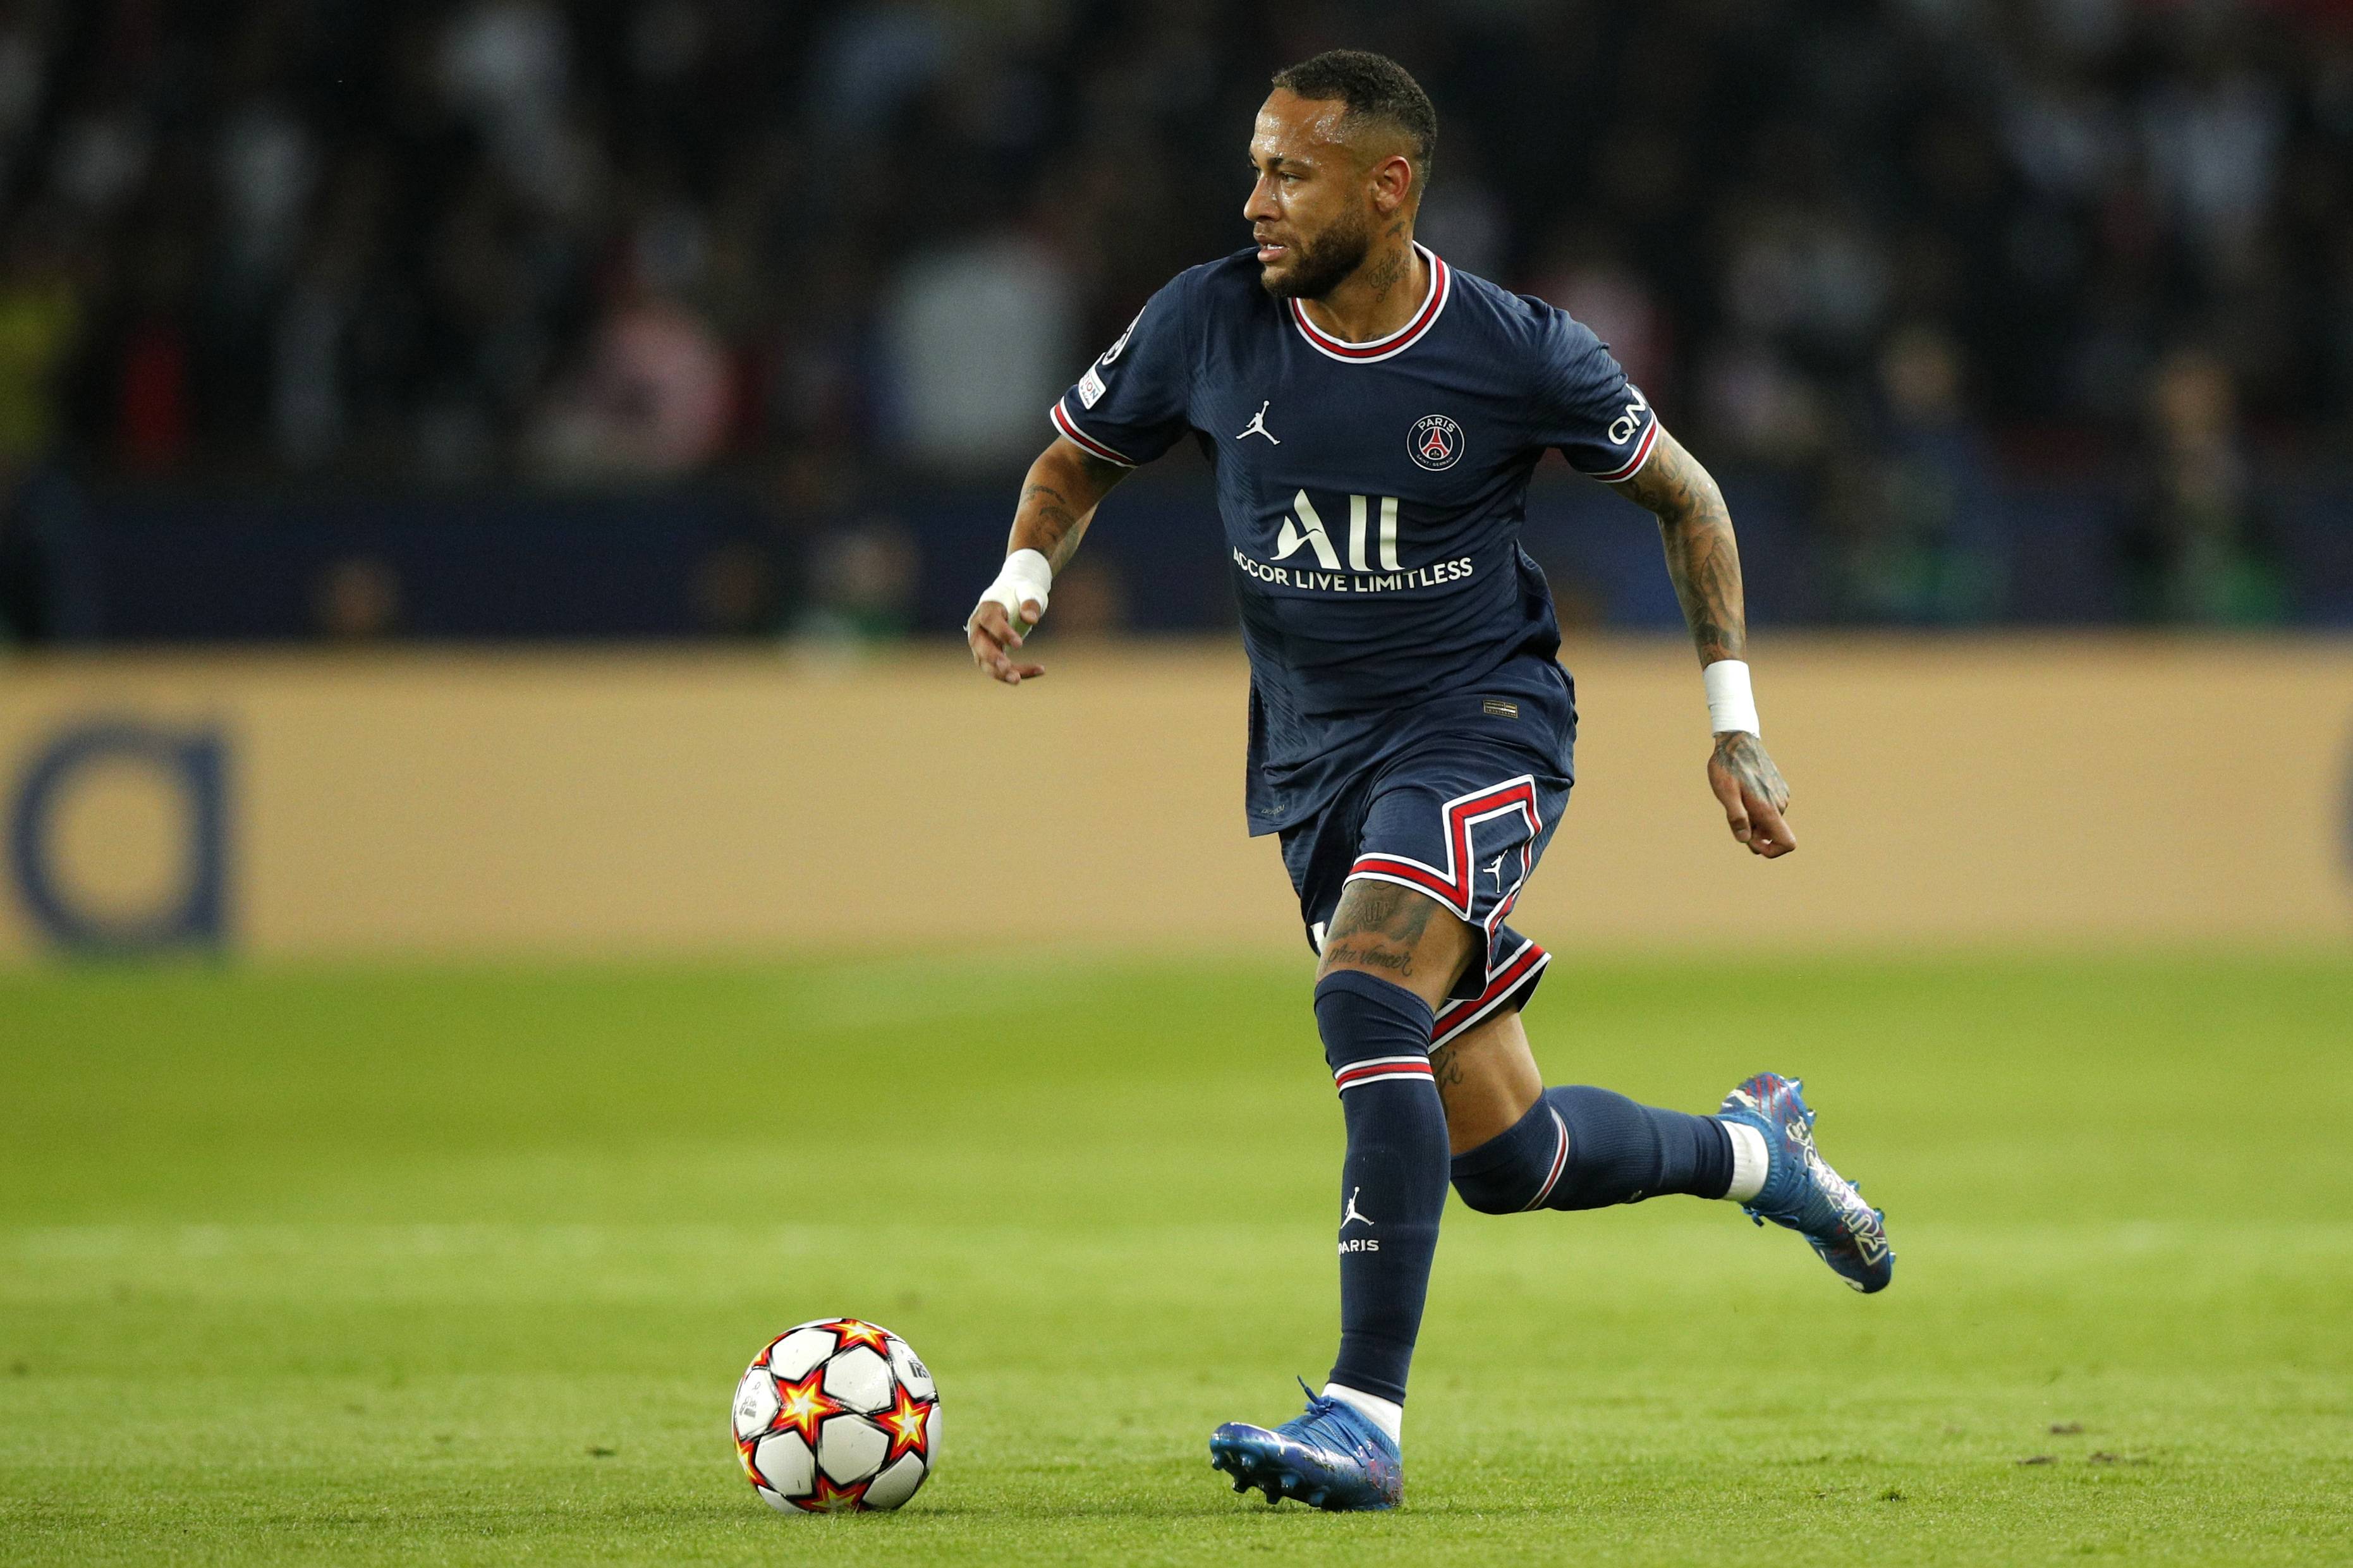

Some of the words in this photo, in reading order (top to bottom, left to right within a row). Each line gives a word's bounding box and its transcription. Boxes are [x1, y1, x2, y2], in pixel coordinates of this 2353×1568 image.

[1418, 417, 1456, 433] PARIS
[1233, 546, 1290, 587] ACCOR
[1296, 571, 1347, 592] LIVE
[1354, 557, 1473, 592] LIMITLESS
[1338, 1239, 1379, 1255] PARIS
